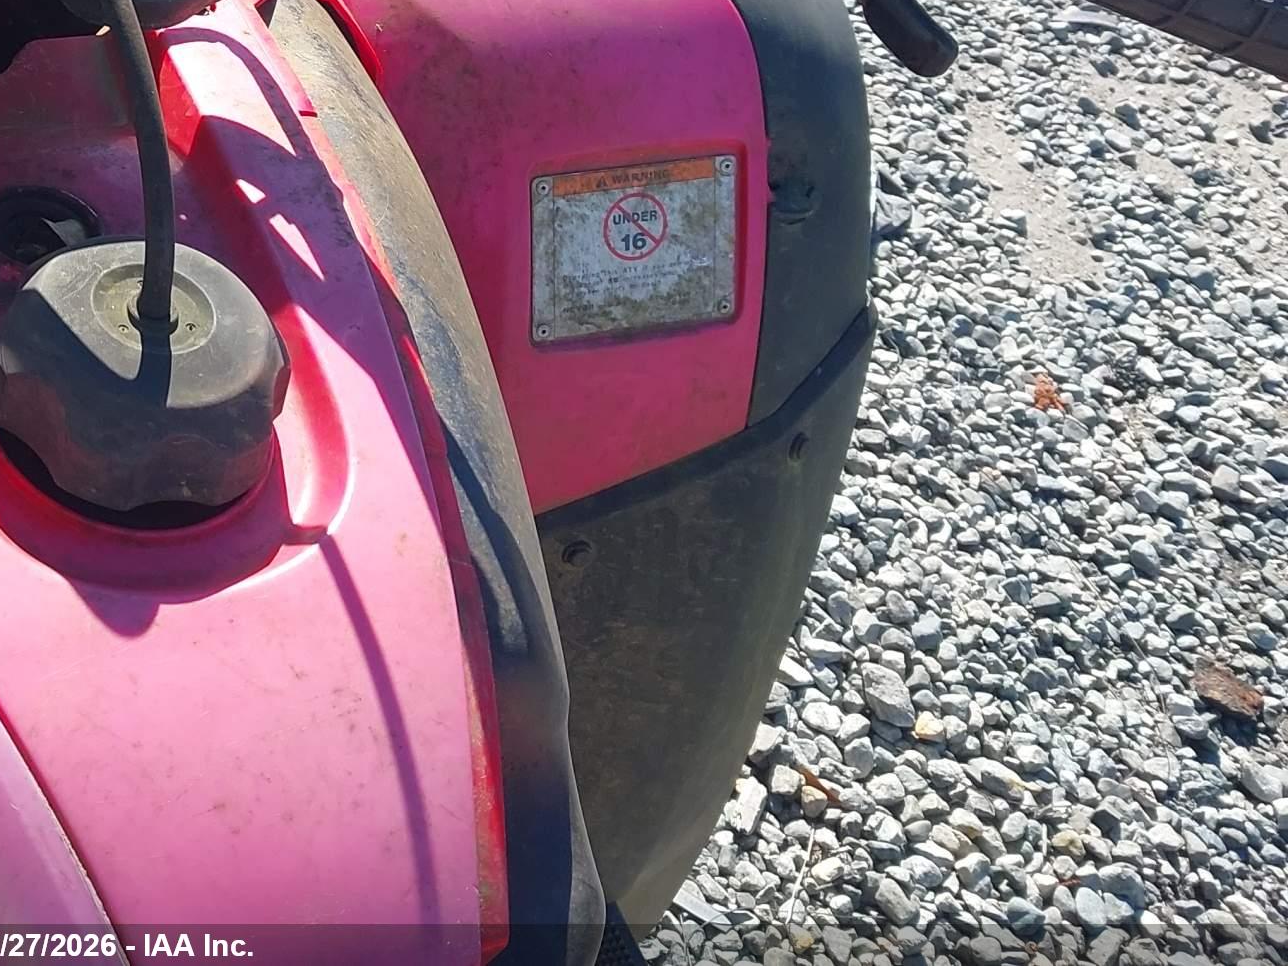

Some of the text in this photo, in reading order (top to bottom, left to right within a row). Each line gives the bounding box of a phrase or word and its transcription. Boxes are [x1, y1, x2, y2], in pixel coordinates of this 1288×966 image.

[612, 169, 669, 184] WARNING
[613, 209, 658, 225] UNDER
[621, 233, 647, 251] 16
